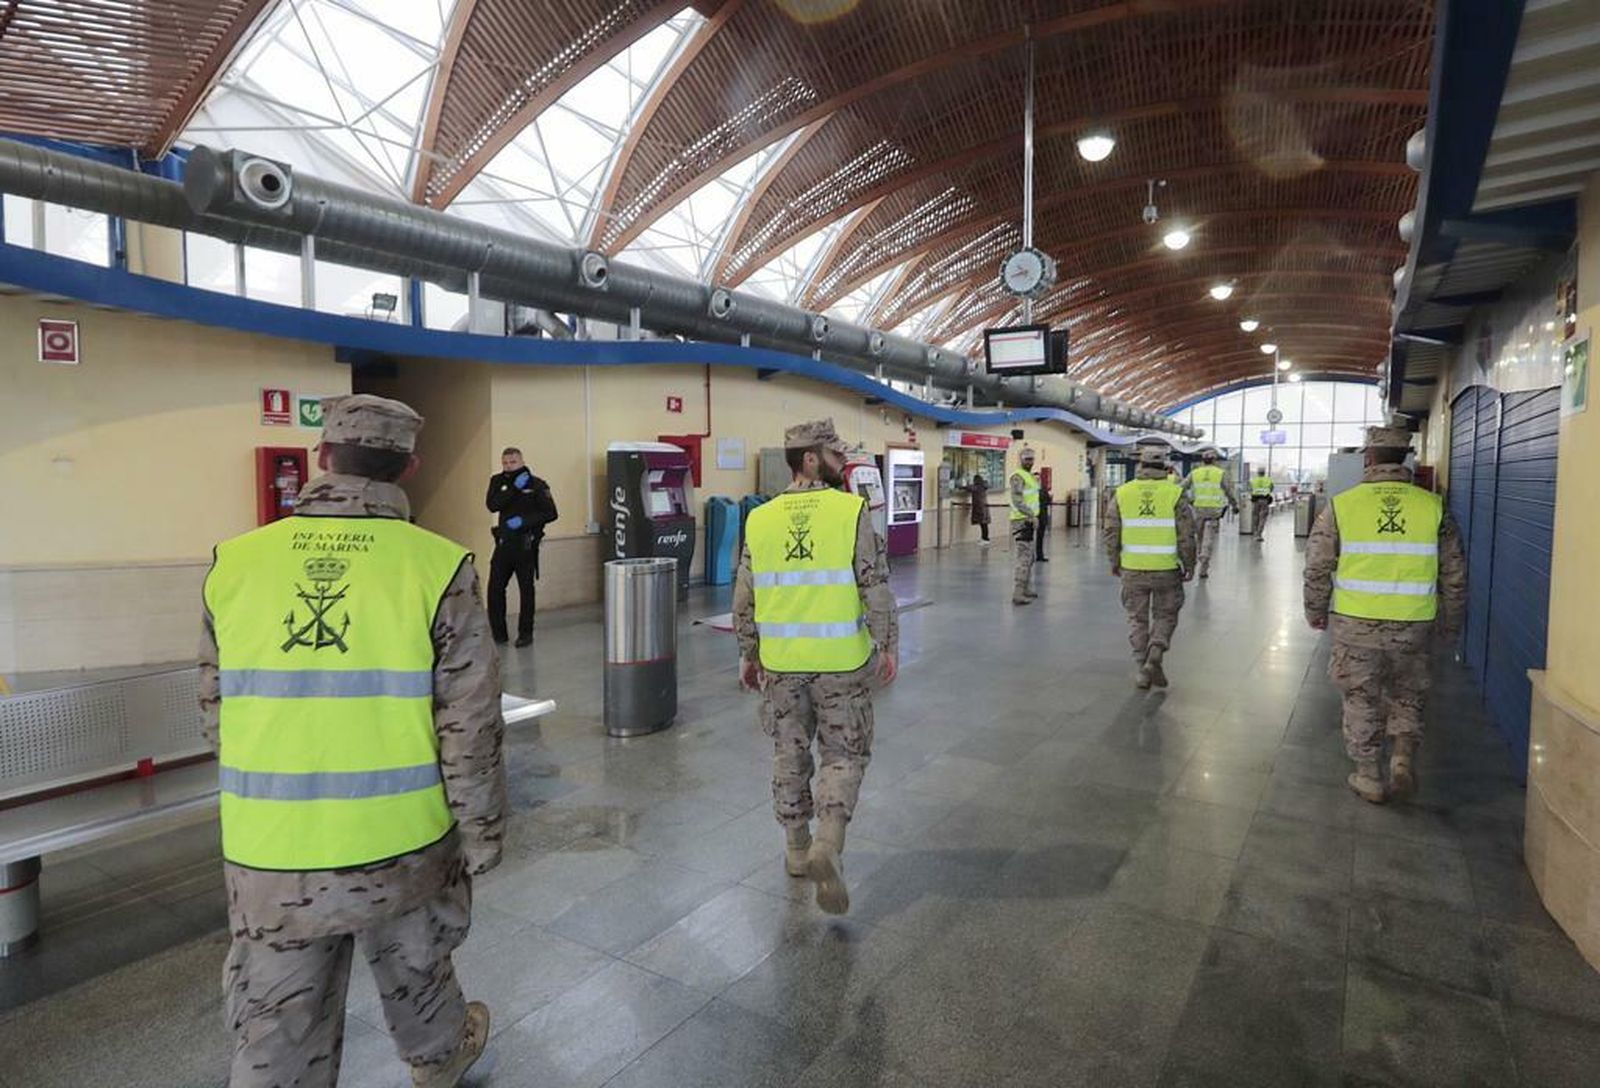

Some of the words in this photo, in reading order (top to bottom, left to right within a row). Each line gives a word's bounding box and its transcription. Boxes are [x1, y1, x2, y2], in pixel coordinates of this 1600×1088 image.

[610, 486, 631, 558] renfe
[292, 541, 309, 551] DE
[313, 542, 369, 553] MARINA
[657, 530, 687, 548] renfe
